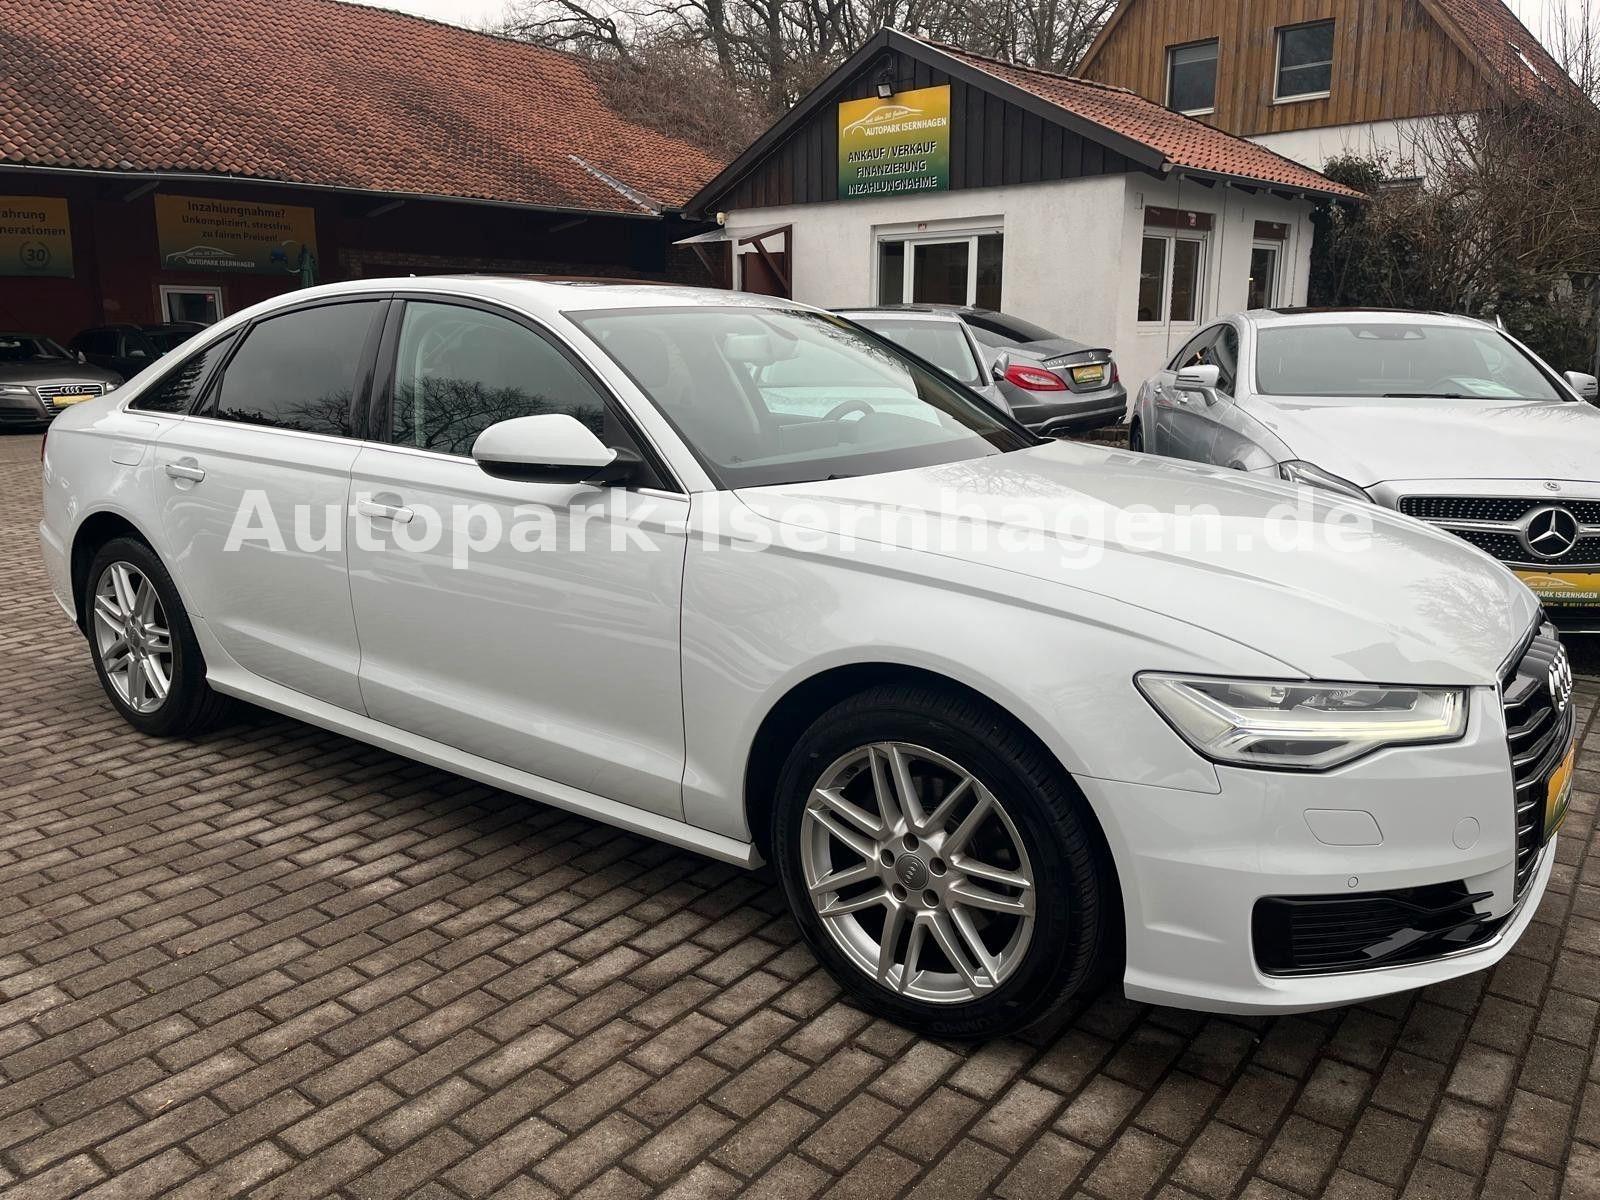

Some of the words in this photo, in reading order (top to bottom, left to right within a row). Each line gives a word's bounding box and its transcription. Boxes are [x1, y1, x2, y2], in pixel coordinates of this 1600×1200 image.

[866, 123, 900, 136] AUTOPARK
[901, 117, 947, 132] ISERNHAGEN
[848, 147, 885, 163] ANKAUF
[892, 141, 937, 158] VERKAUF
[857, 160, 927, 178] FINANZIERUNG
[848, 176, 938, 195] INZAHLUNGNAHME
[187, 200, 286, 218] Inzahlungnahme?
[201, 231, 213, 239] zu
[214, 230, 242, 241] fairen
[26, 249, 46, 262] 30
[187, 258, 219, 267] AUTOPARK
[1555, 591, 1598, 599] ISERNHAGEN
